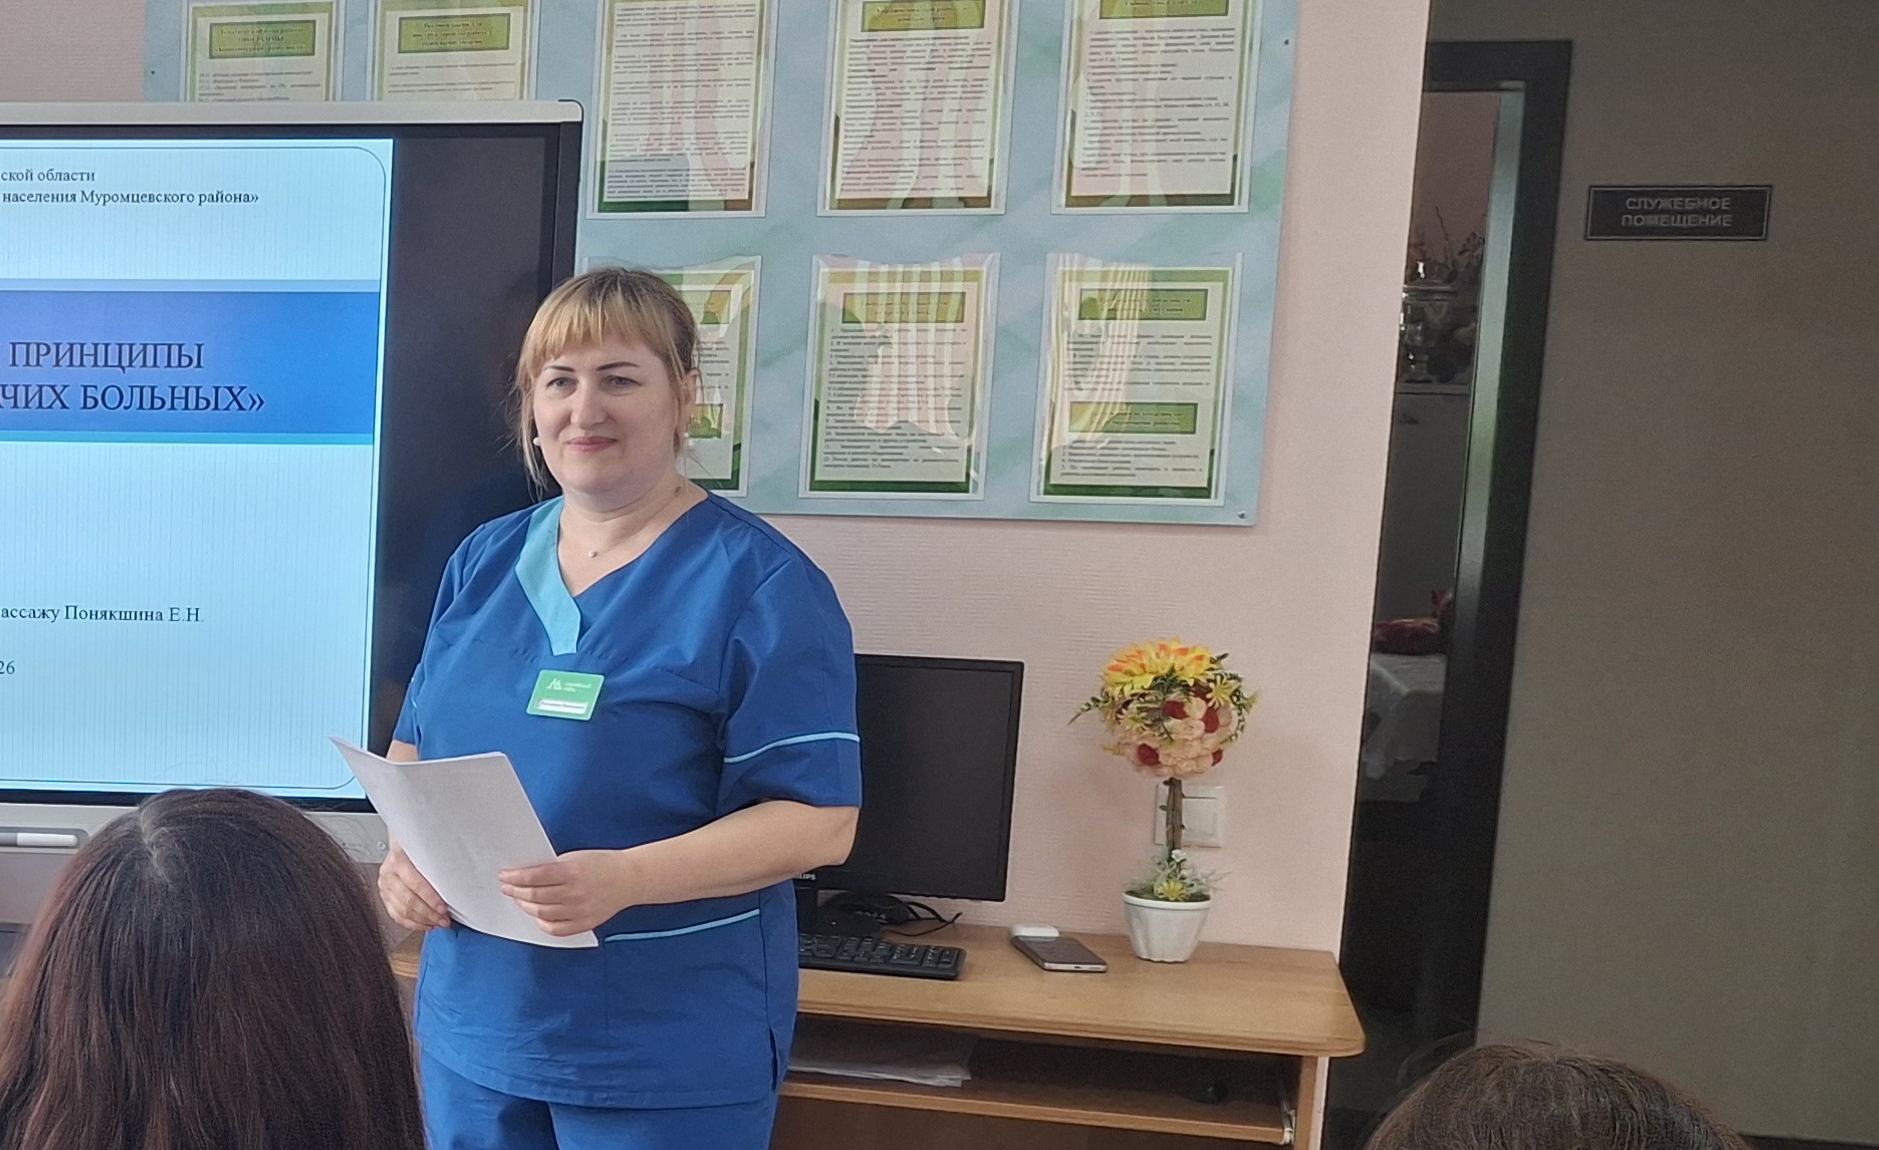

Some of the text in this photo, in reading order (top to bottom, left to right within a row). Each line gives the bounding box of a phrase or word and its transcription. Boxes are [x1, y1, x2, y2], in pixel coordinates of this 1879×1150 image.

[37, 169, 96, 182] области
[2, 193, 76, 203] населения
[80, 190, 195, 207] Муромцевского
[198, 191, 259, 207] района»
[1625, 197, 1732, 210] СЛУЖЕБНОЕ
[9, 341, 205, 373] ПРИНЦИПЫ
[80, 384, 265, 411] БОЛЬНЫХ»
[64, 605, 163, 622] Понякшина
